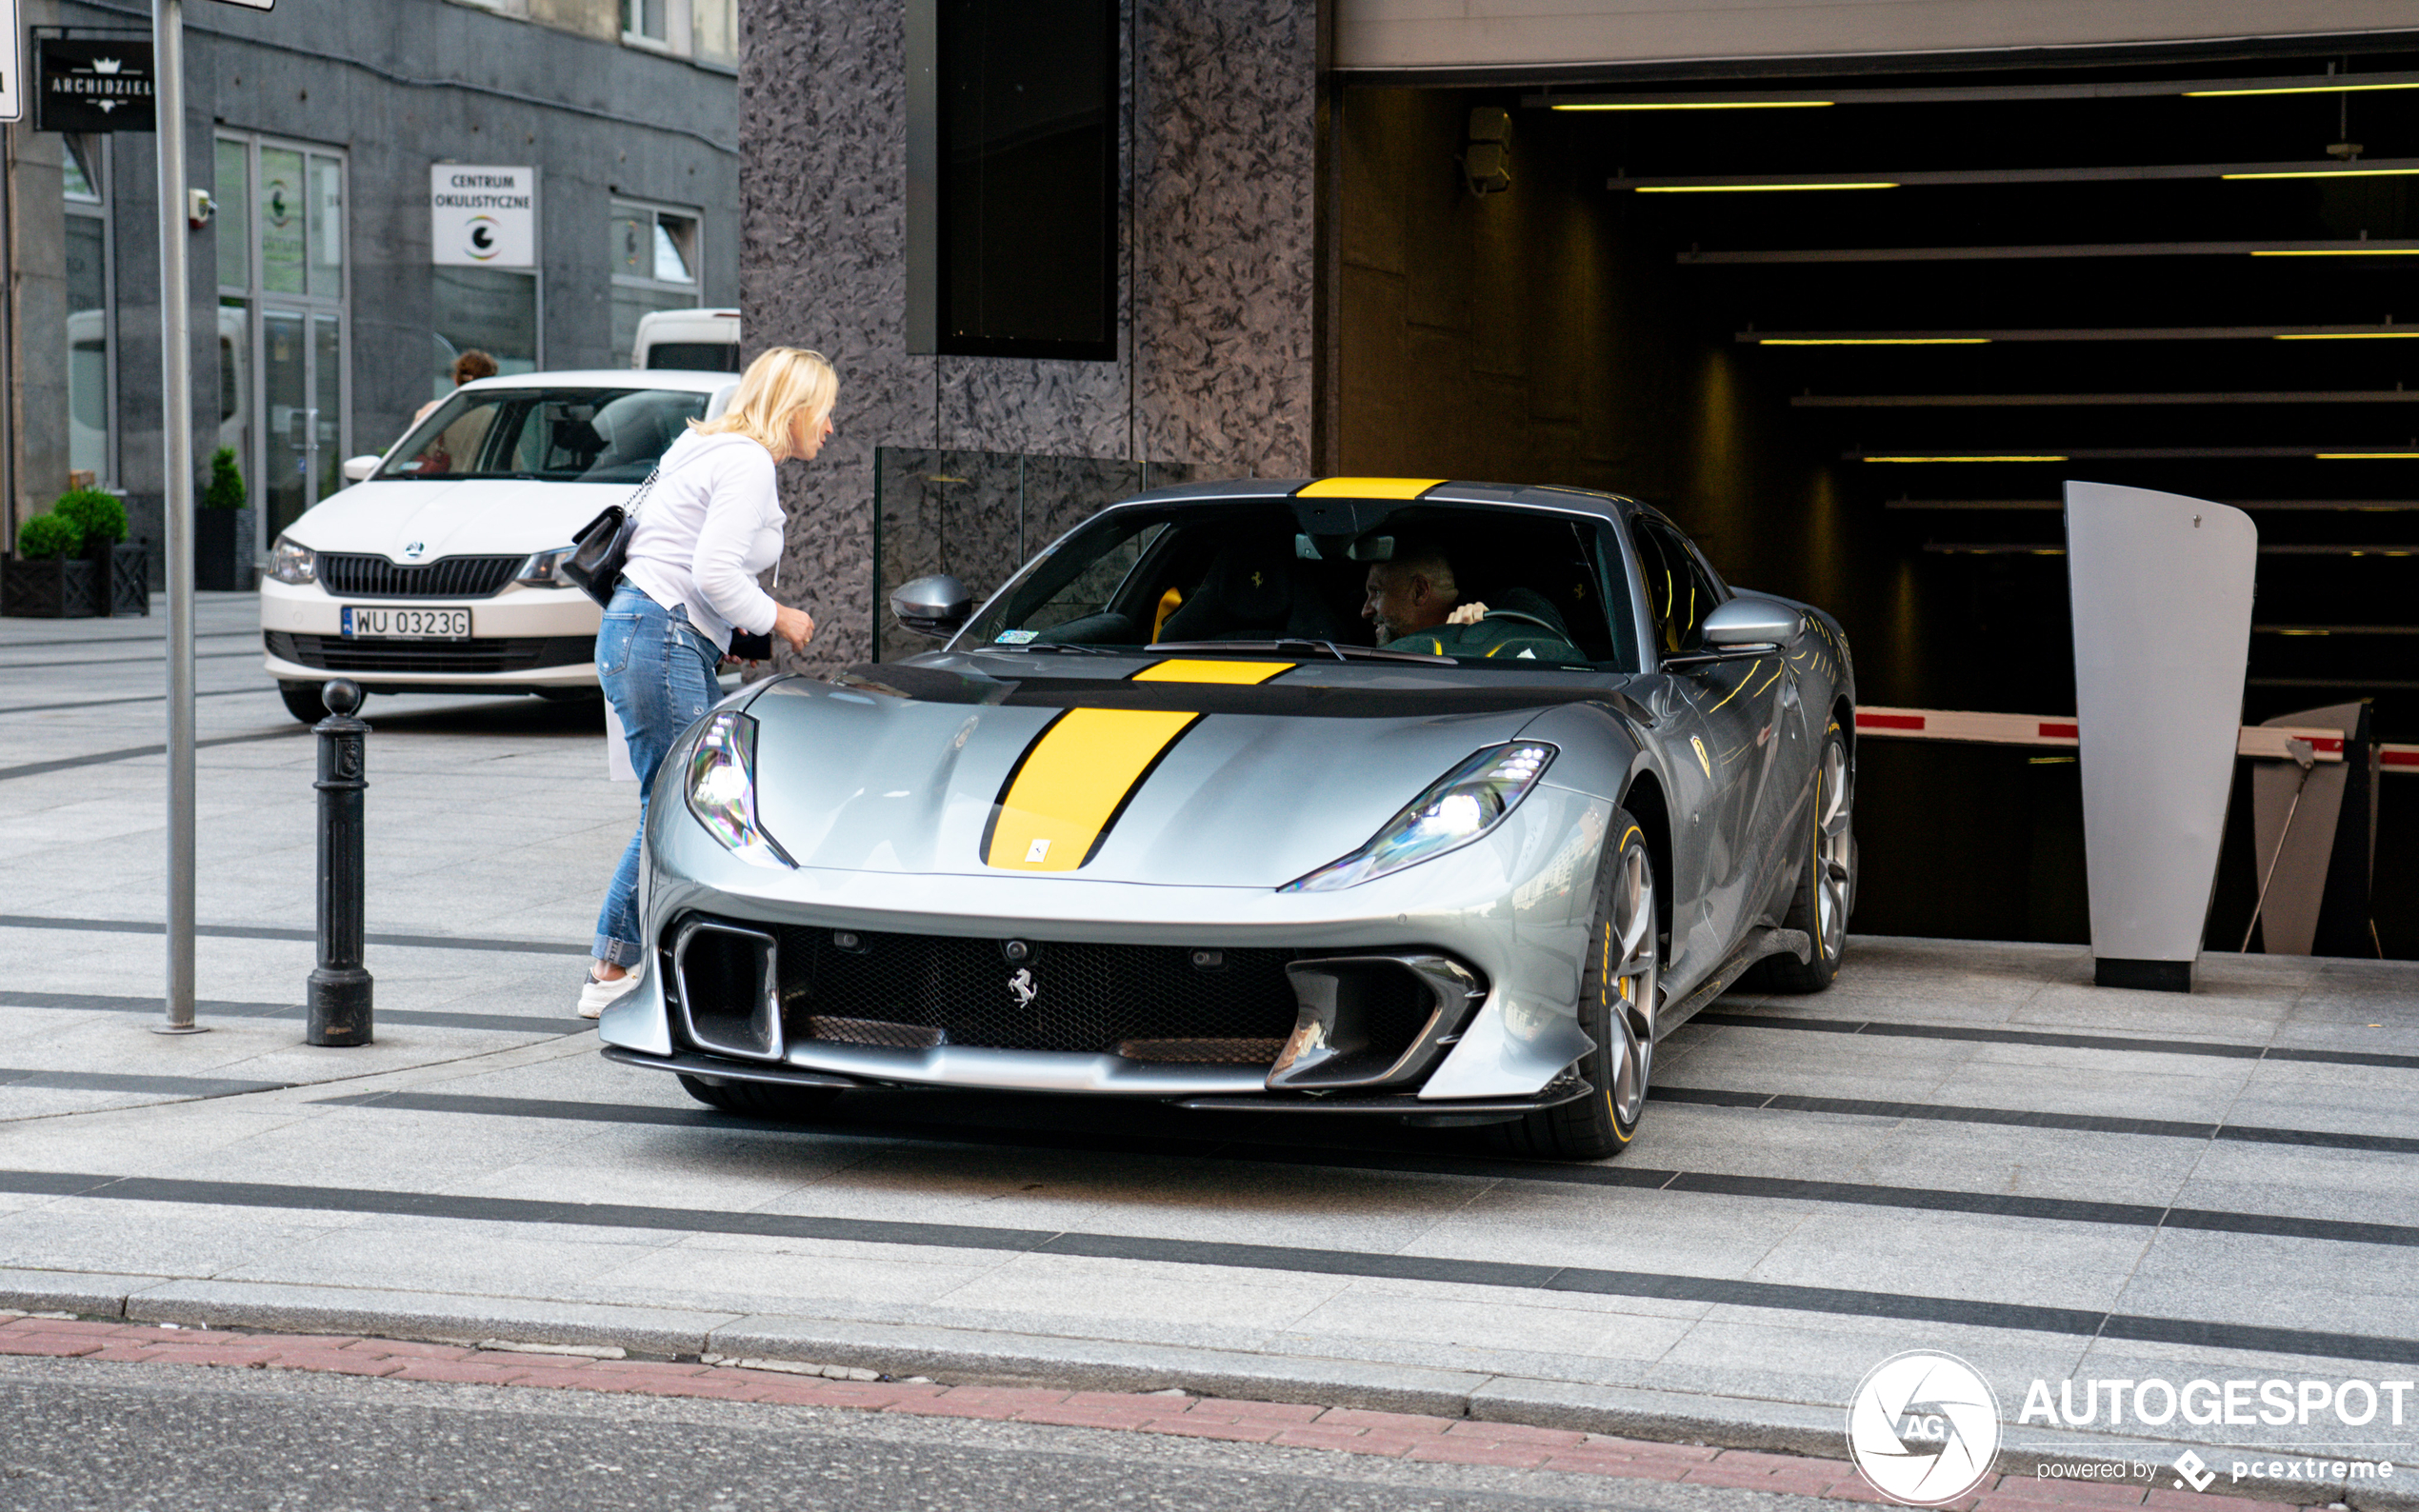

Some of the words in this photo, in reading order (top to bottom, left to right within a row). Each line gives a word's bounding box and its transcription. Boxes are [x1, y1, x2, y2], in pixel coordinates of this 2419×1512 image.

[52, 77, 155, 95] ARCHIDZIEL
[450, 174, 515, 189] CENTRUM
[435, 194, 530, 209] OKULISTYCZNE
[356, 610, 388, 633] WU
[396, 611, 466, 634] 0323G
